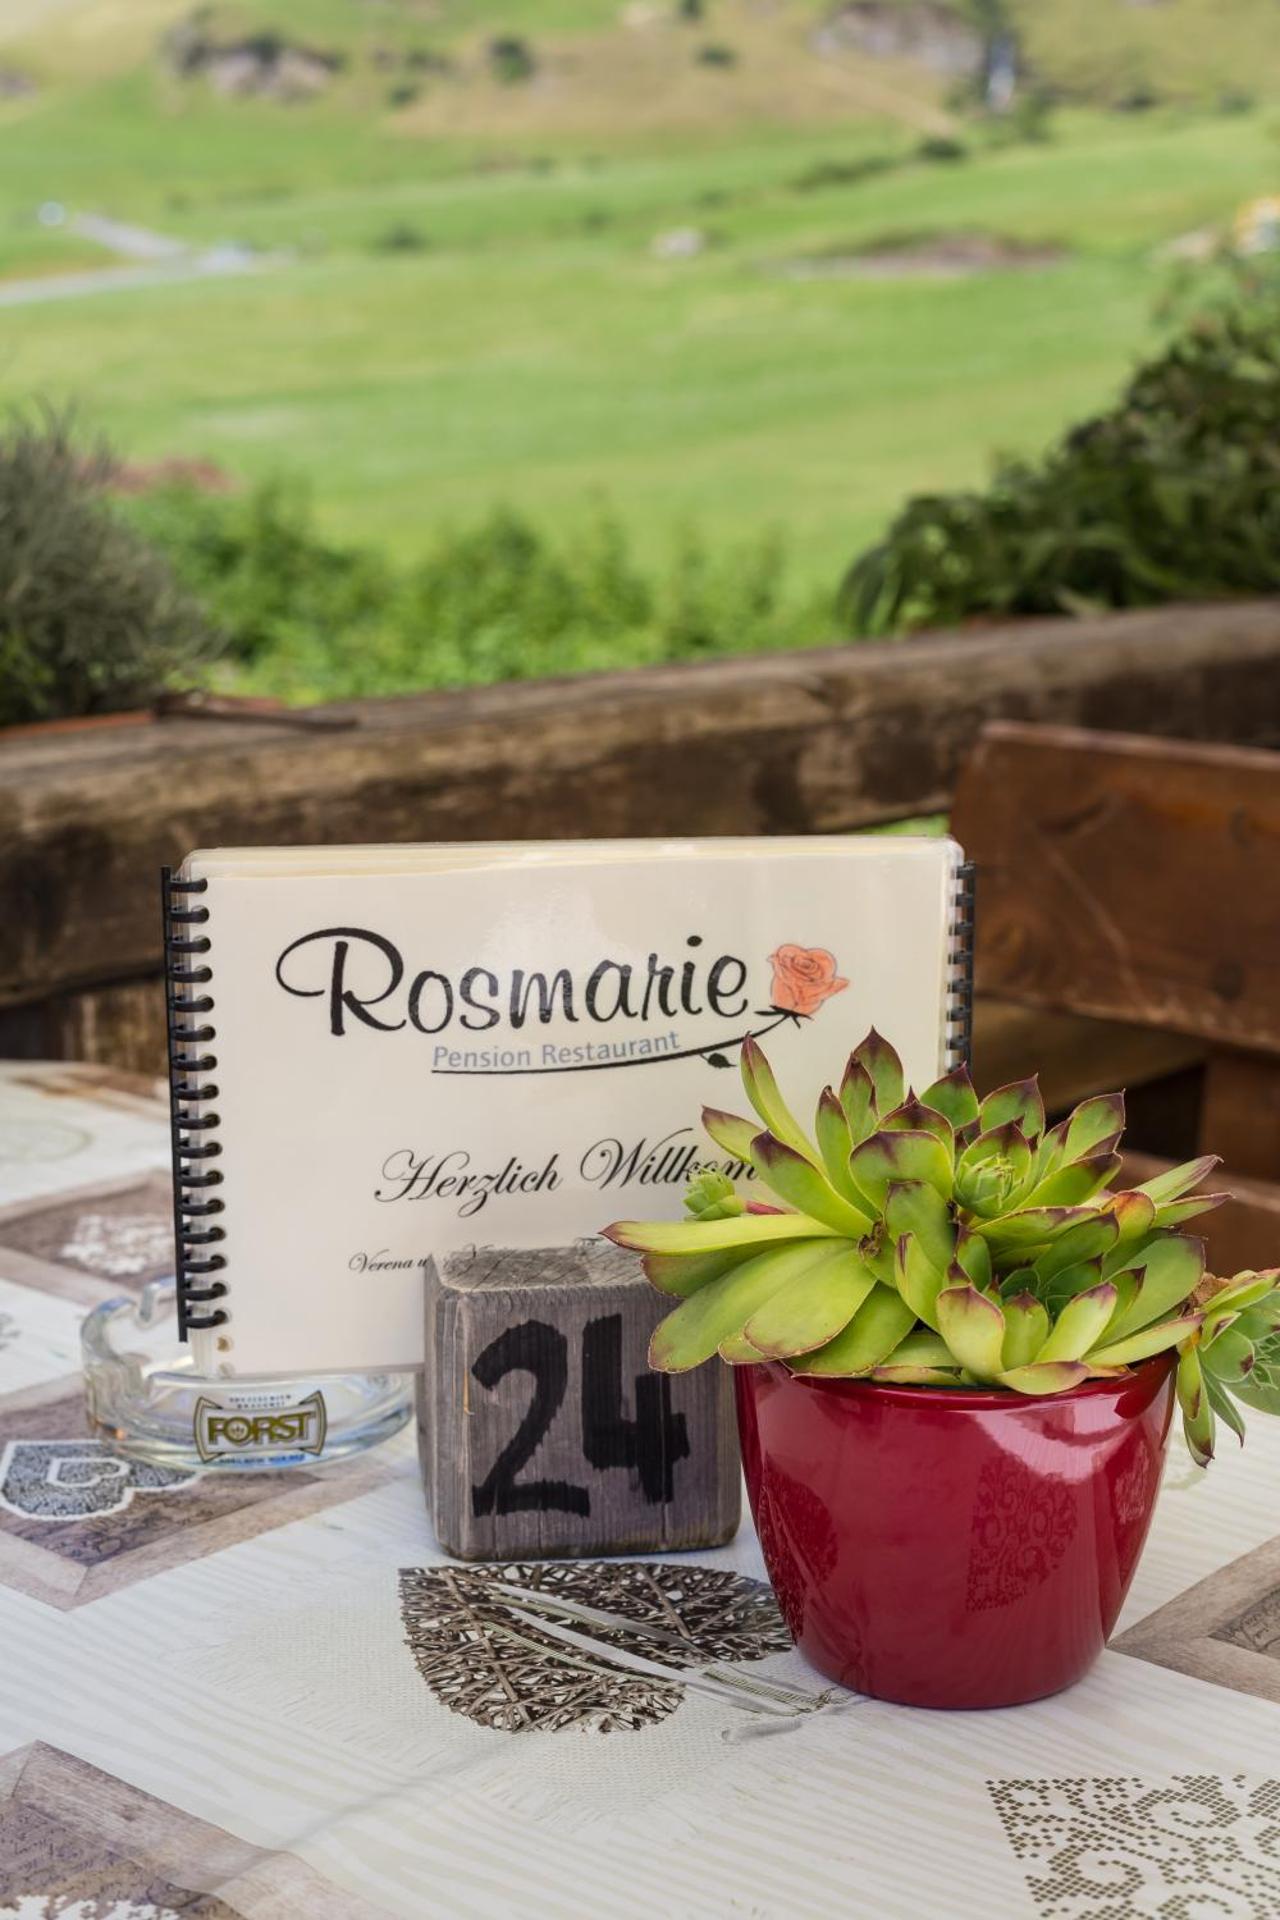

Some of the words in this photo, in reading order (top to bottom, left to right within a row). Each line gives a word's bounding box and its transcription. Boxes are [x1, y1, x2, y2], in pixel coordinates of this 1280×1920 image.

[276, 927, 749, 1036] Rosmarie
[433, 1045, 531, 1068] Pension
[542, 1031, 681, 1065] Restaurant
[374, 1150, 563, 1217] Herzlich
[580, 1127, 759, 1191] Willkom
[348, 1248, 413, 1274] Verena
[207, 1411, 316, 1446] FORST
[471, 1313, 690, 1518] 24
